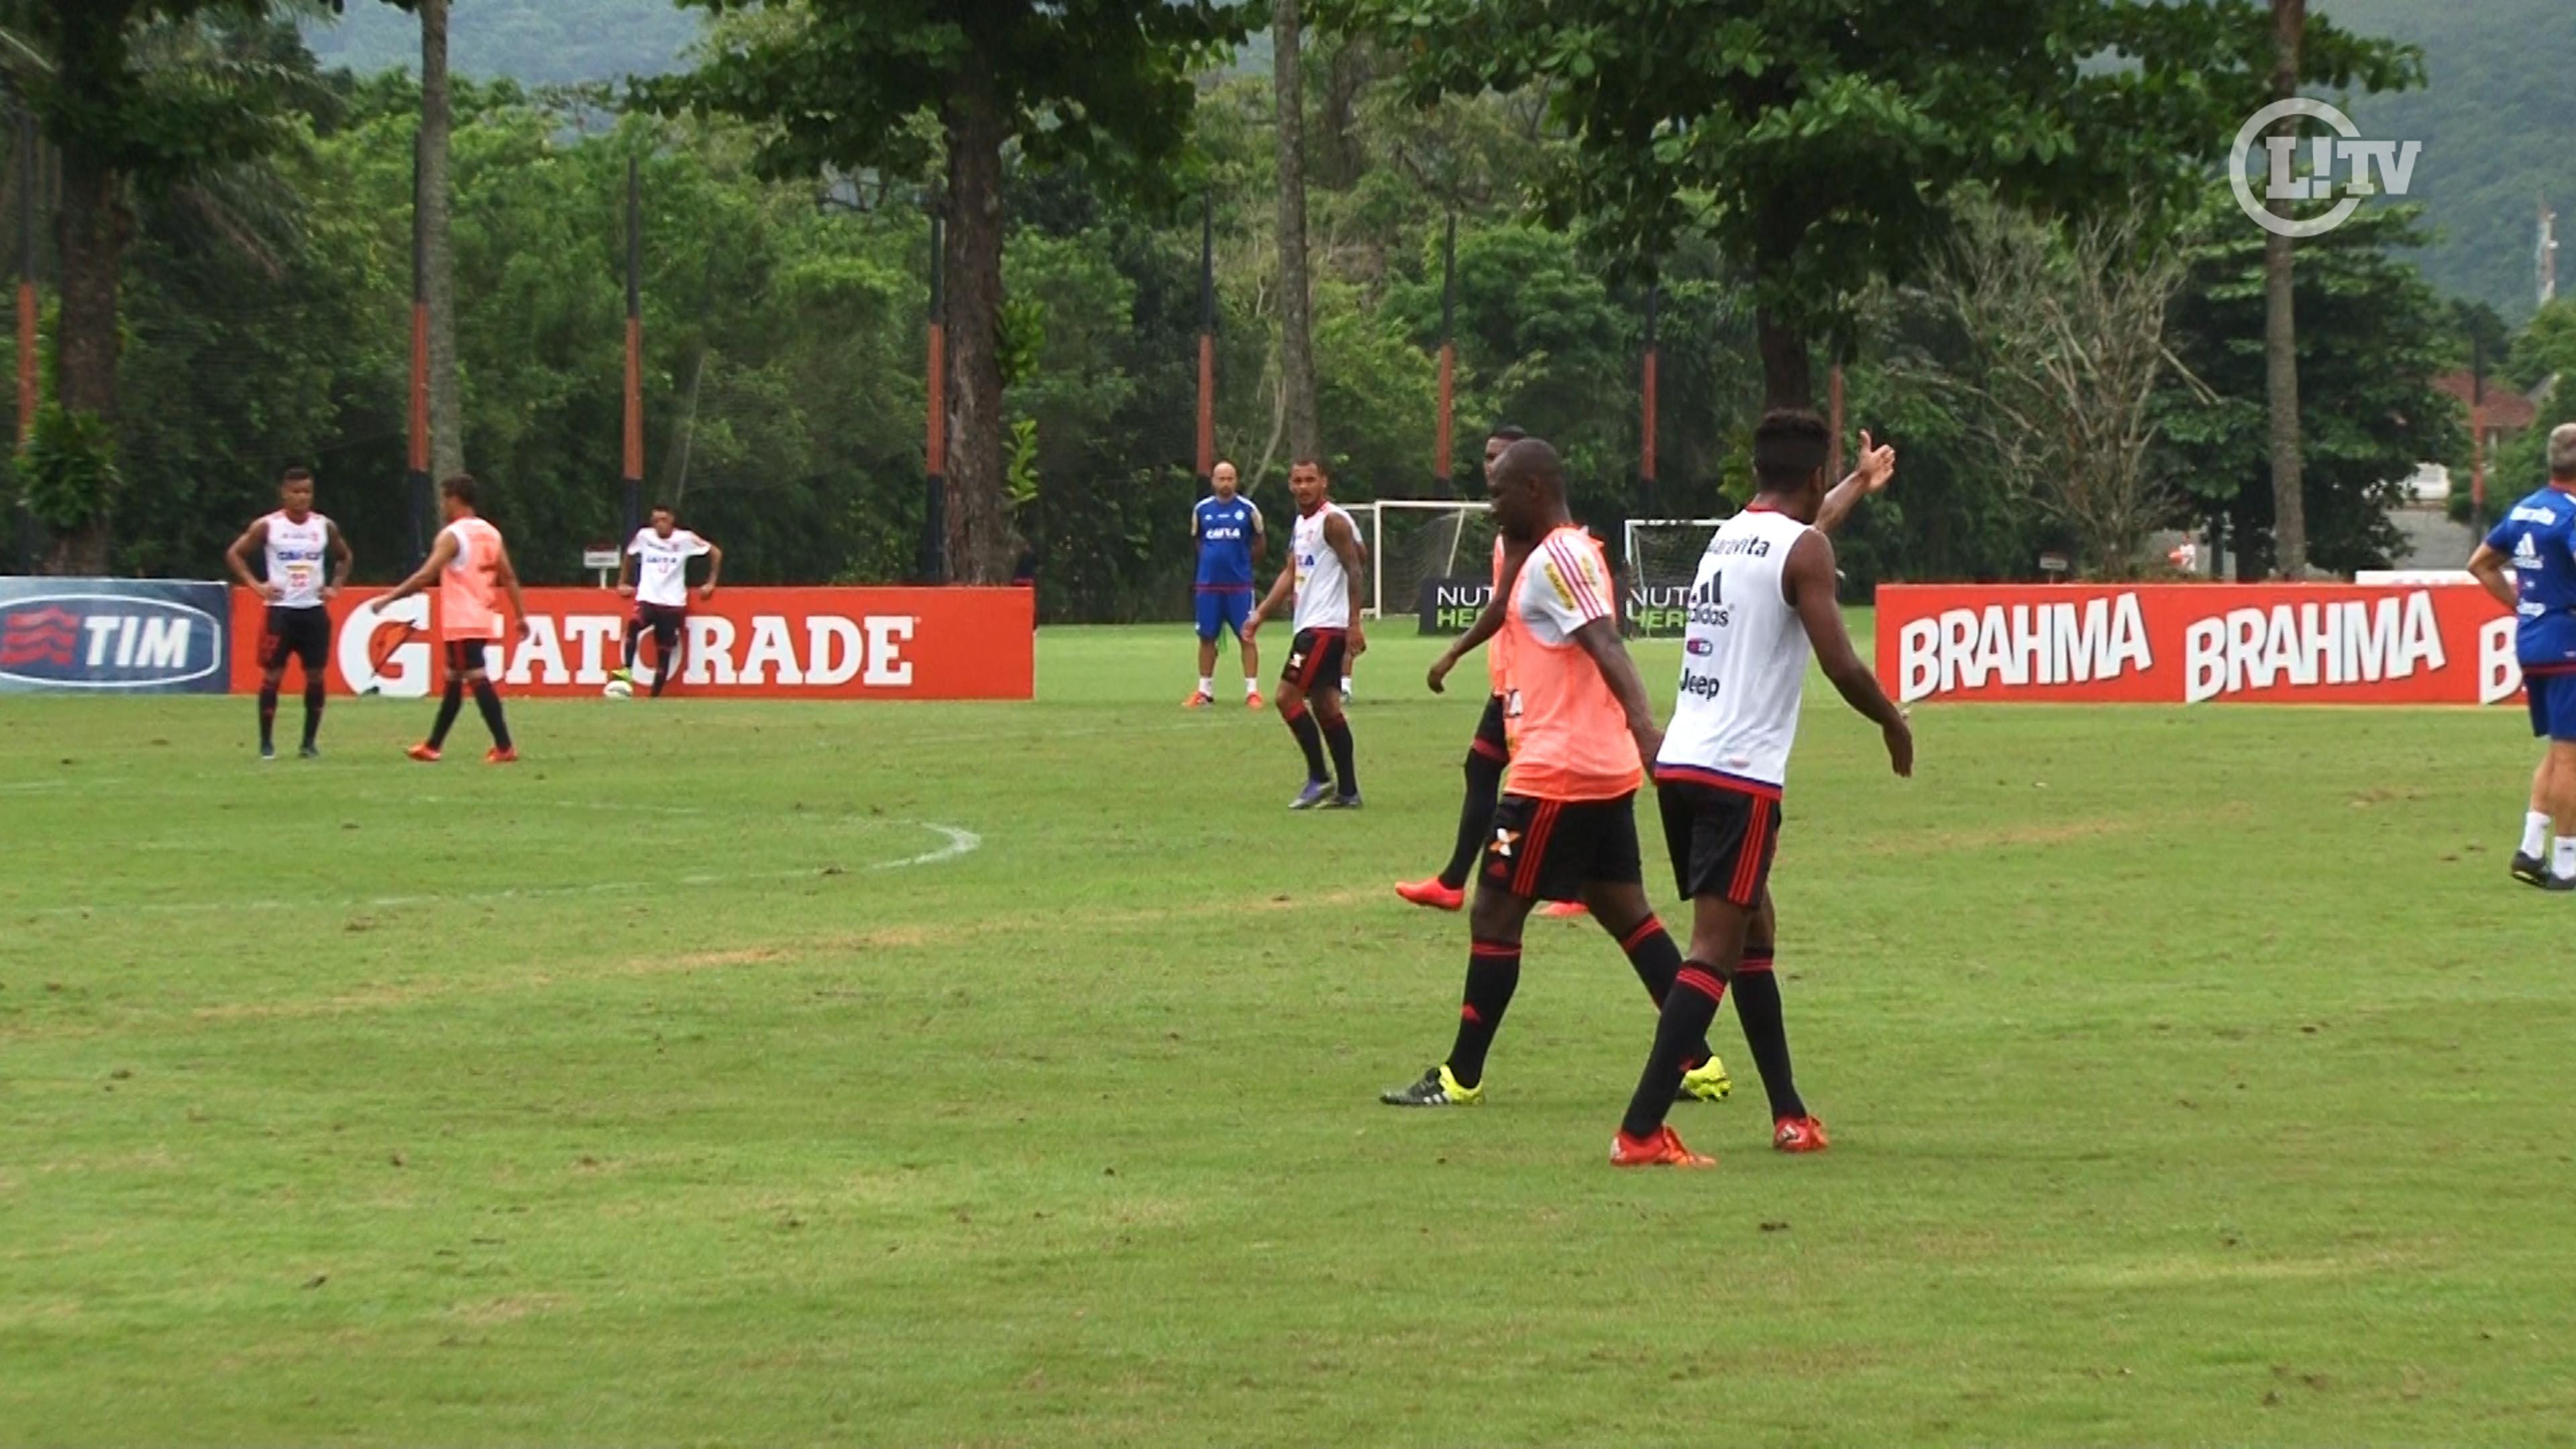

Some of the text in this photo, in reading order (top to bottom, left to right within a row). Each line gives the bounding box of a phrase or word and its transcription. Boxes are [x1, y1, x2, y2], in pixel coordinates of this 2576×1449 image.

[84, 615, 192, 669] TIM
[486, 613, 914, 686] ATORADE
[1899, 592, 2153, 703] BRAHMA
[2186, 590, 2447, 704] BRAHMA
[2479, 615, 2527, 705] B
[1680, 667, 1720, 702] Jeep
